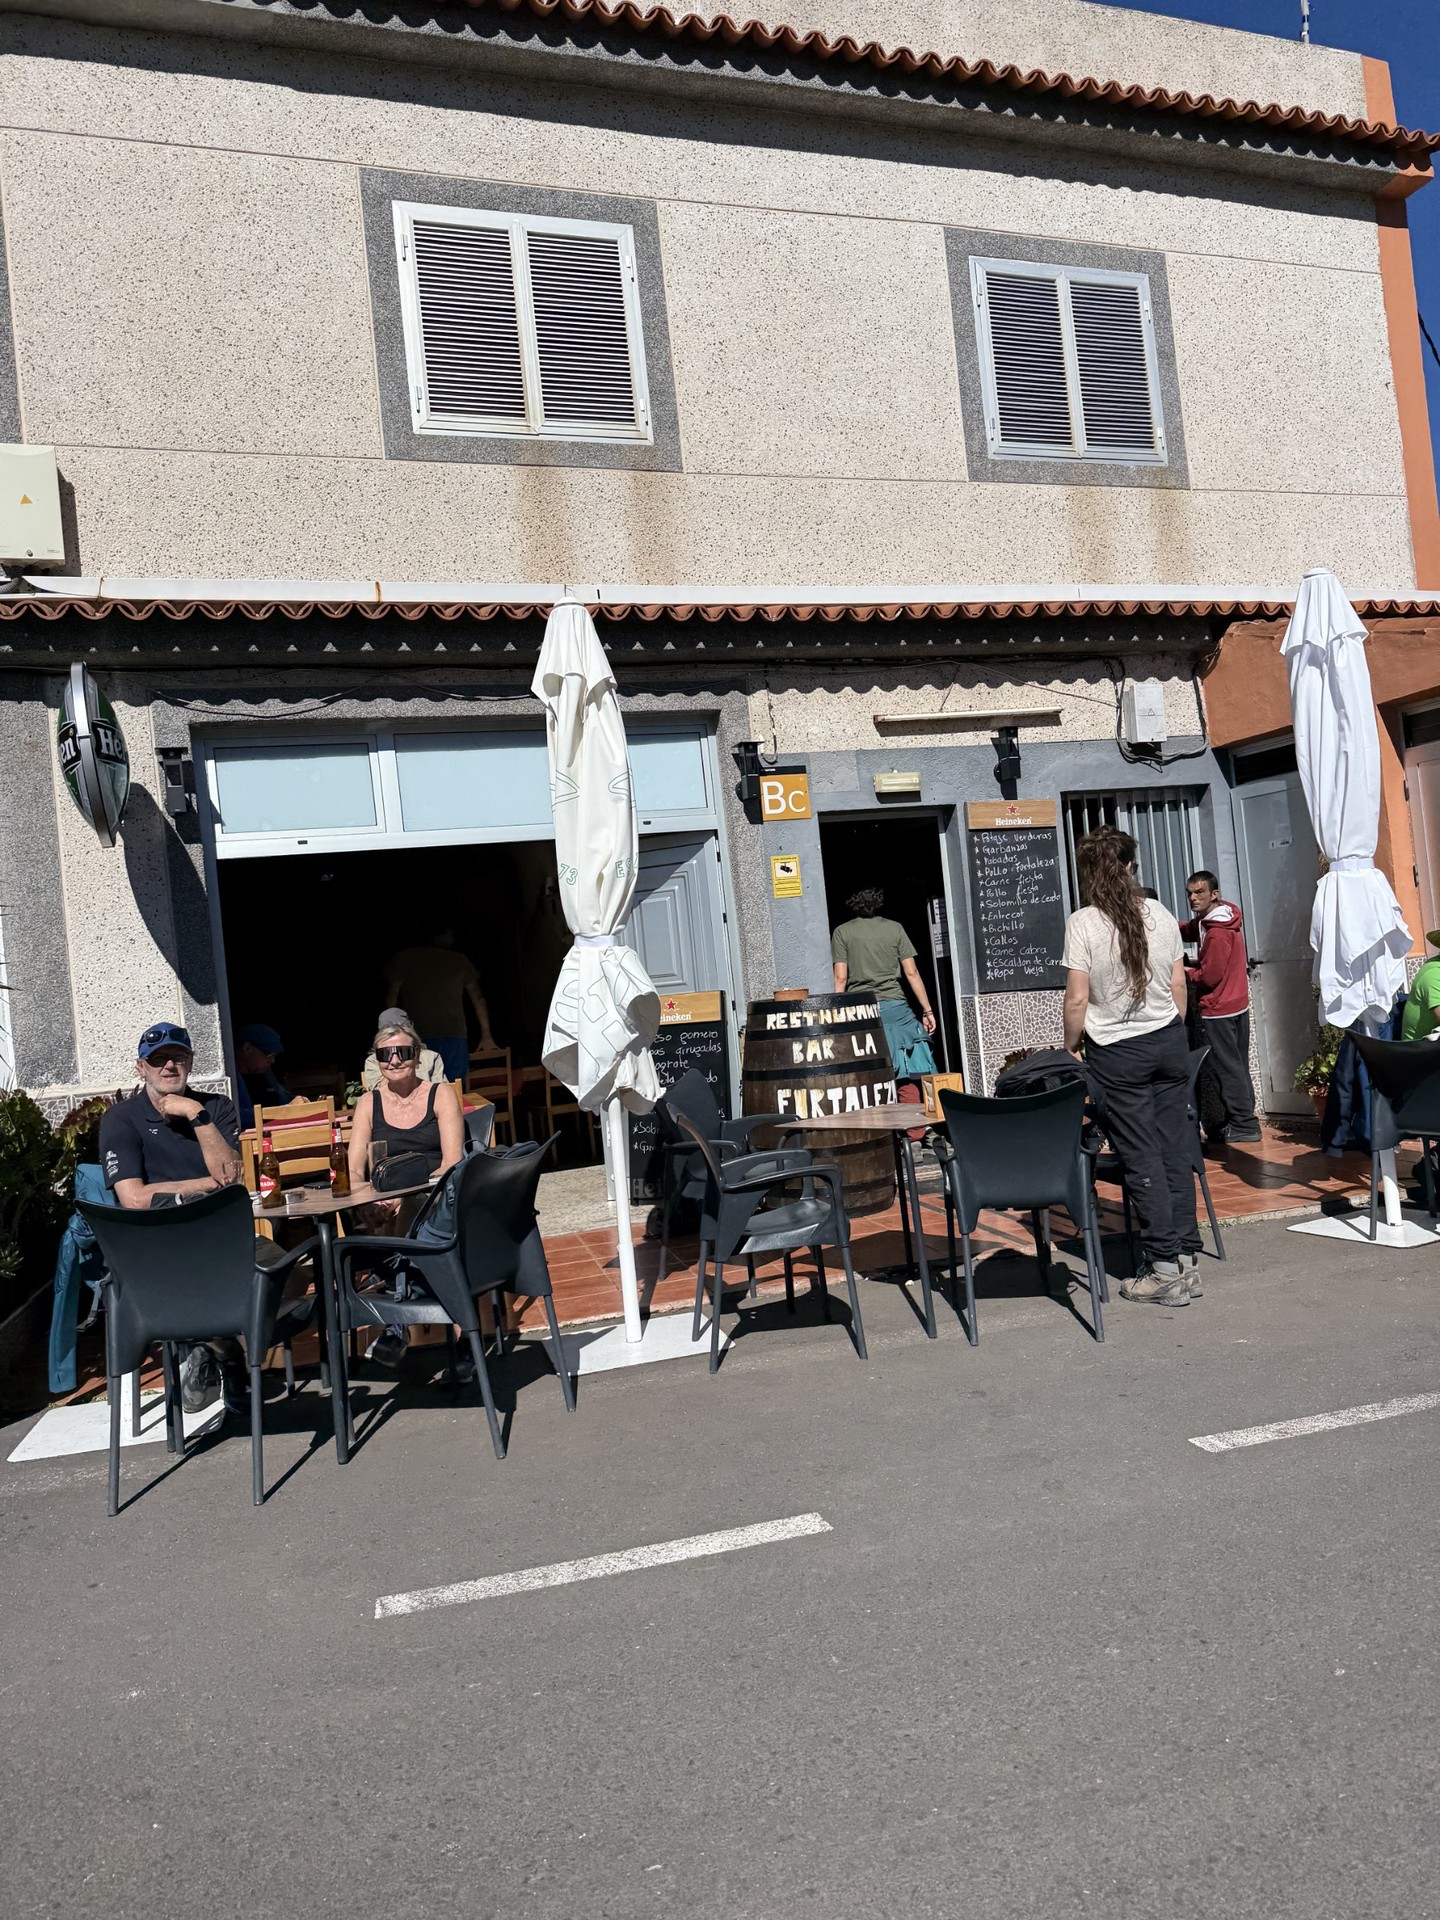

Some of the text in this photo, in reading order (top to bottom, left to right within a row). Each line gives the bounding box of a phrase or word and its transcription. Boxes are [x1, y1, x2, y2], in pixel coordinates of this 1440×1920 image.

[762, 781, 806, 814] Bc
[995, 817, 1032, 826] Heineken
[989, 934, 1019, 946] Callos
[660, 1013, 691, 1022] eineken
[792, 1033, 877, 1064] BAR LA
